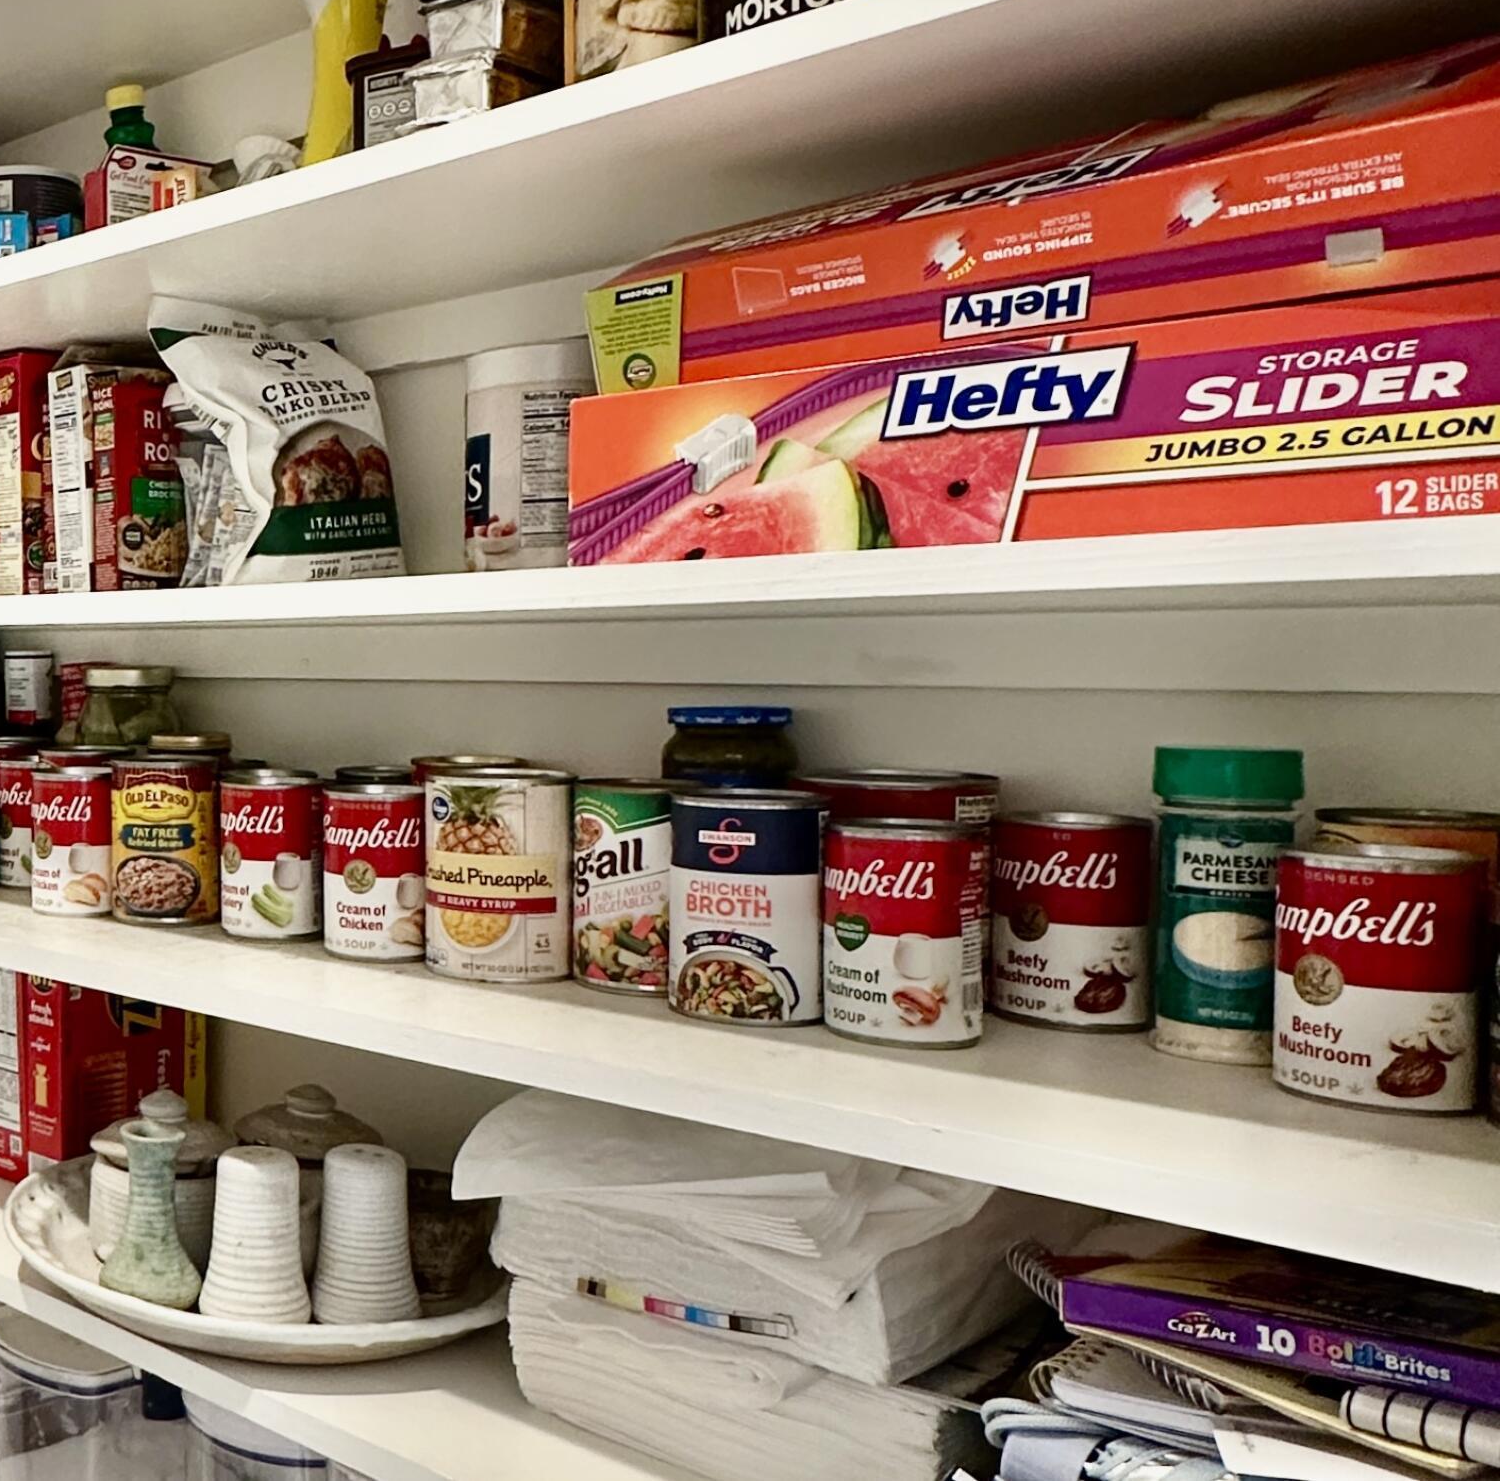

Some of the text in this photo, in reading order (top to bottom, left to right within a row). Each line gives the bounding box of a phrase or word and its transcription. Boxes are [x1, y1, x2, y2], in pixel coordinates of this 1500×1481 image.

[1342, 154, 1383, 171] EXTRA
[1385, 151, 1403, 164] AN
[921, 150, 1145, 208] Hefty
[1286, 164, 1403, 191] TRACK DESIGN FOR
[1292, 161, 1340, 179] STRONG
[1331, 179, 1378, 199] SURE
[1381, 175, 1405, 191] BE
[1295, 187, 1327, 205] IT'S
[1019, 229, 1038, 242] THE
[982, 230, 1093, 264] ZIPPING SOUND
[789, 273, 866, 297] BIGGER BAGS
[950, 284, 1082, 328] Hefty
[1257, 338, 1419, 376] STORAGE
[92, 387, 113, 401] RICE
[262, 379, 350, 404] CRISPY
[318, 390, 372, 408] BLEND
[523, 392, 557, 402] Nutrition
[900, 360, 1115, 424] Hefty
[1179, 359, 1470, 423] SLIDER
[143, 410, 162, 430] RI
[1144, 415, 1497, 464] JUMBO 2.5 GALLON
[1426, 472, 1500, 494] SLIDER
[1374, 478, 1419, 516] 12
[1426, 491, 1485, 512] BAGS
[309, 512, 359, 530] ITALIAN
[304, 530, 327, 541] WITH
[124, 792, 145, 807] OLD
[145, 790, 160, 802] EL
[31, 795, 93, 823] mpbell's
[132, 826, 180, 838] FAT FREE
[701, 831, 754, 844] SWANSON
[1182, 850, 1277, 870] PARMESAN
[824, 859, 937, 900] ampbell's
[994, 851, 1119, 892] ampbell's
[1190, 868, 1270, 886] CHEESE
[689, 879, 767, 898] CHICKEN
[336, 900, 387, 917] Cream of
[446, 896, 479, 908] HEAVY
[481, 899, 517, 910] SYRUP
[686, 894, 773, 919] BROTH
[338, 916, 384, 932] Chicken
[1276, 897, 1438, 948] ampbell's
[343, 938, 377, 951] SOUP
[1006, 949, 1049, 972] Beefy
[828, 959, 881, 985] Cream of
[1006, 993, 1047, 1012] SOUP
[831, 1006, 867, 1025] SOUP
[1291, 1015, 1344, 1045] Beefy
[1278, 1031, 1373, 1069] Mushroom
[1290, 1068, 1341, 1092] SOUP
[1255, 1324, 1451, 1382] 10 Bold Brites
